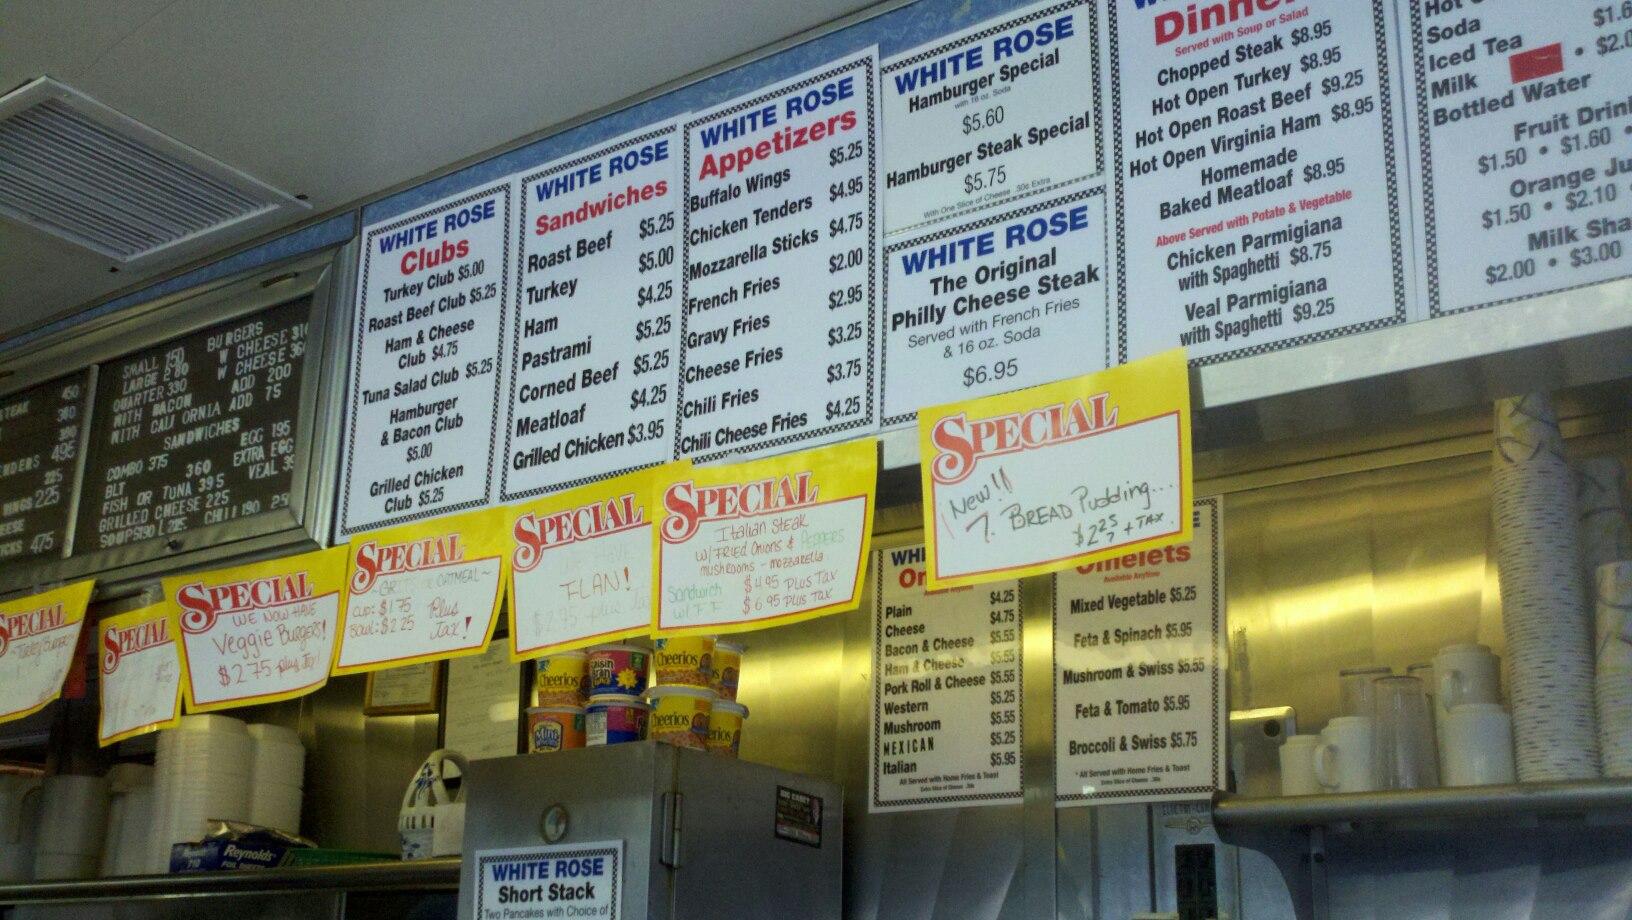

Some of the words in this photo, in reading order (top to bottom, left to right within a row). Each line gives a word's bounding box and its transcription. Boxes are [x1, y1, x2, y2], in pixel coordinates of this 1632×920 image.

[1155, 0, 1296, 46] Dinne
[1175, 39, 1209, 57] Served
[1212, 31, 1234, 44] with
[1237, 22, 1263, 38] Soup
[1265, 18, 1276, 28] or
[1279, 6, 1309, 24] Salad
[1427, 18, 1481, 44] Soda
[895, 46, 984, 95] WHITE
[993, 15, 1074, 62] ROSE
[1157, 50, 1229, 87] Chopped
[1235, 34, 1283, 63] Steak
[1291, 20, 1332, 46] $8.95
[1429, 43, 1476, 72] Iced
[1483, 34, 1523, 56] Tea
[909, 72, 994, 113] Hamburger
[1000, 48, 1060, 82] Special
[1152, 93, 1180, 116] Hot
[1186, 82, 1228, 106] Open
[1234, 63, 1291, 91] Turkey
[1300, 46, 1342, 73] $8.95
[1431, 73, 1479, 99] Milk
[1433, 90, 1515, 126] Bottled
[1522, 73, 1592, 103] Water
[700, 105, 777, 148] WHITE
[786, 76, 853, 119] ROSE
[962, 105, 1004, 135] $5.60
[1514, 113, 1570, 142] Fruit
[699, 110, 857, 181] Appetizers
[887, 151, 973, 189] Hamburger
[977, 133, 1023, 160] Steak
[1028, 111, 1089, 145] Special
[1478, 147, 1527, 176] $1.50
[1560, 126, 1611, 155] $1.60
[536, 163, 602, 202] WHITE
[609, 140, 669, 177] ROSE
[691, 184, 741, 212] Buffalo
[746, 168, 791, 194] Wings
[829, 140, 862, 168] $5.25
[964, 165, 1006, 194] $5.75
[379, 220, 438, 254] WHITE
[444, 200, 495, 233] ROSE
[536, 180, 668, 235] Sandwiches
[1156, 232, 1186, 247] Above
[1189, 221, 1224, 240] Served
[1226, 214, 1249, 229] with
[1252, 206, 1285, 222] Potato
[1288, 202, 1296, 213] &
[1299, 189, 1352, 211] Vegetable
[400, 239, 469, 275] Clubs
[528, 244, 571, 273] Roast
[577, 230, 613, 258] Beef
[639, 211, 674, 239] $5.25
[902, 232, 994, 275] WHITE
[1006, 205, 1088, 249] ROSE
[1167, 240, 1236, 271] Chicken
[1242, 215, 1343, 253] Parmigiana
[1528, 226, 1579, 251] Milk
[384, 282, 423, 302] Turkey
[427, 271, 454, 290] Club
[458, 259, 485, 281] $5.00
[930, 275, 968, 296] The
[975, 247, 1057, 285] Original
[1178, 270, 1209, 291] with
[1213, 252, 1280, 285] Spaghetti
[1290, 240, 1332, 266] $8.75
[1486, 258, 1535, 286] $2.00
[1570, 240, 1622, 268] $3.00
[368, 313, 403, 333] Roast
[407, 302, 434, 322] Beef
[438, 293, 466, 313] Club
[469, 283, 496, 305] $5.25
[892, 304, 947, 332] Philly
[953, 284, 1031, 315] Cheese
[1038, 264, 1099, 294] Steak
[207, 322, 264, 352] BURGERS
[908, 327, 955, 348] Served
[960, 318, 987, 334] with
[993, 306, 1040, 327] French
[1045, 297, 1080, 315] Fries
[943, 346, 953, 358] &
[958, 342, 974, 354] 16
[978, 338, 998, 349] oz.
[1004, 326, 1041, 344] Soda
[963, 358, 1018, 388] $6.95
[164, 417, 240, 450] SANDWICHES
[931, 393, 1118, 485] SPECIAL
[370, 475, 410, 497] Grilled
[414, 464, 464, 487] Chicken
[384, 495, 412, 513] Club
[418, 487, 444, 507] $5.25
[661, 472, 819, 544] SPECIAL
[513, 494, 644, 573] SPECIAL
[350, 533, 466, 595] SPECIAL
[560, 566, 631, 600] FLAN!
[177, 572, 314, 634] SPECIAL
[886, 606, 912, 619] Plain
[990, 590, 1014, 605] $4.25
[1071, 597, 1104, 614] Mixed
[1108, 589, 1166, 611] Vegetable
[1170, 586, 1196, 604] $5.25
[102, 617, 169, 675] SPECIAL
[886, 624, 925, 638] Cheese
[990, 609, 1014, 625] $4.75
[1074, 634, 1099, 648] Feta
[1103, 630, 1110, 644] &
[1114, 625, 1162, 645] Spinach
[1166, 622, 1192, 639] $5.95
[540, 673, 579, 688] Cheerios
[656, 651, 698, 667] Cheerios
[884, 701, 928, 715] Western
[991, 690, 1015, 705] $5.25
[884, 720, 941, 735] Mushroom
[991, 710, 1015, 726] $5.55
[884, 737, 934, 756] MEXICAN
[991, 731, 1016, 746] $5.25
[1069, 737, 1115, 755] Broccoli
[1120, 736, 1127, 751] &
[1132, 734, 1167, 749] Swiss
[1171, 732, 1197, 748] $5.75
[223, 845, 273, 862] Reynolds
[492, 861, 550, 881] WHITE
[556, 858, 604, 878] ROSE
[485, 909, 500, 920] Two
[503, 907, 544, 919] Pancakes
[549, 907, 564, 917] with
[567, 905, 597, 917] Choice
[600, 905, 609, 916] of
[499, 885, 543, 903] Short
[548, 882, 595, 900] Stack
